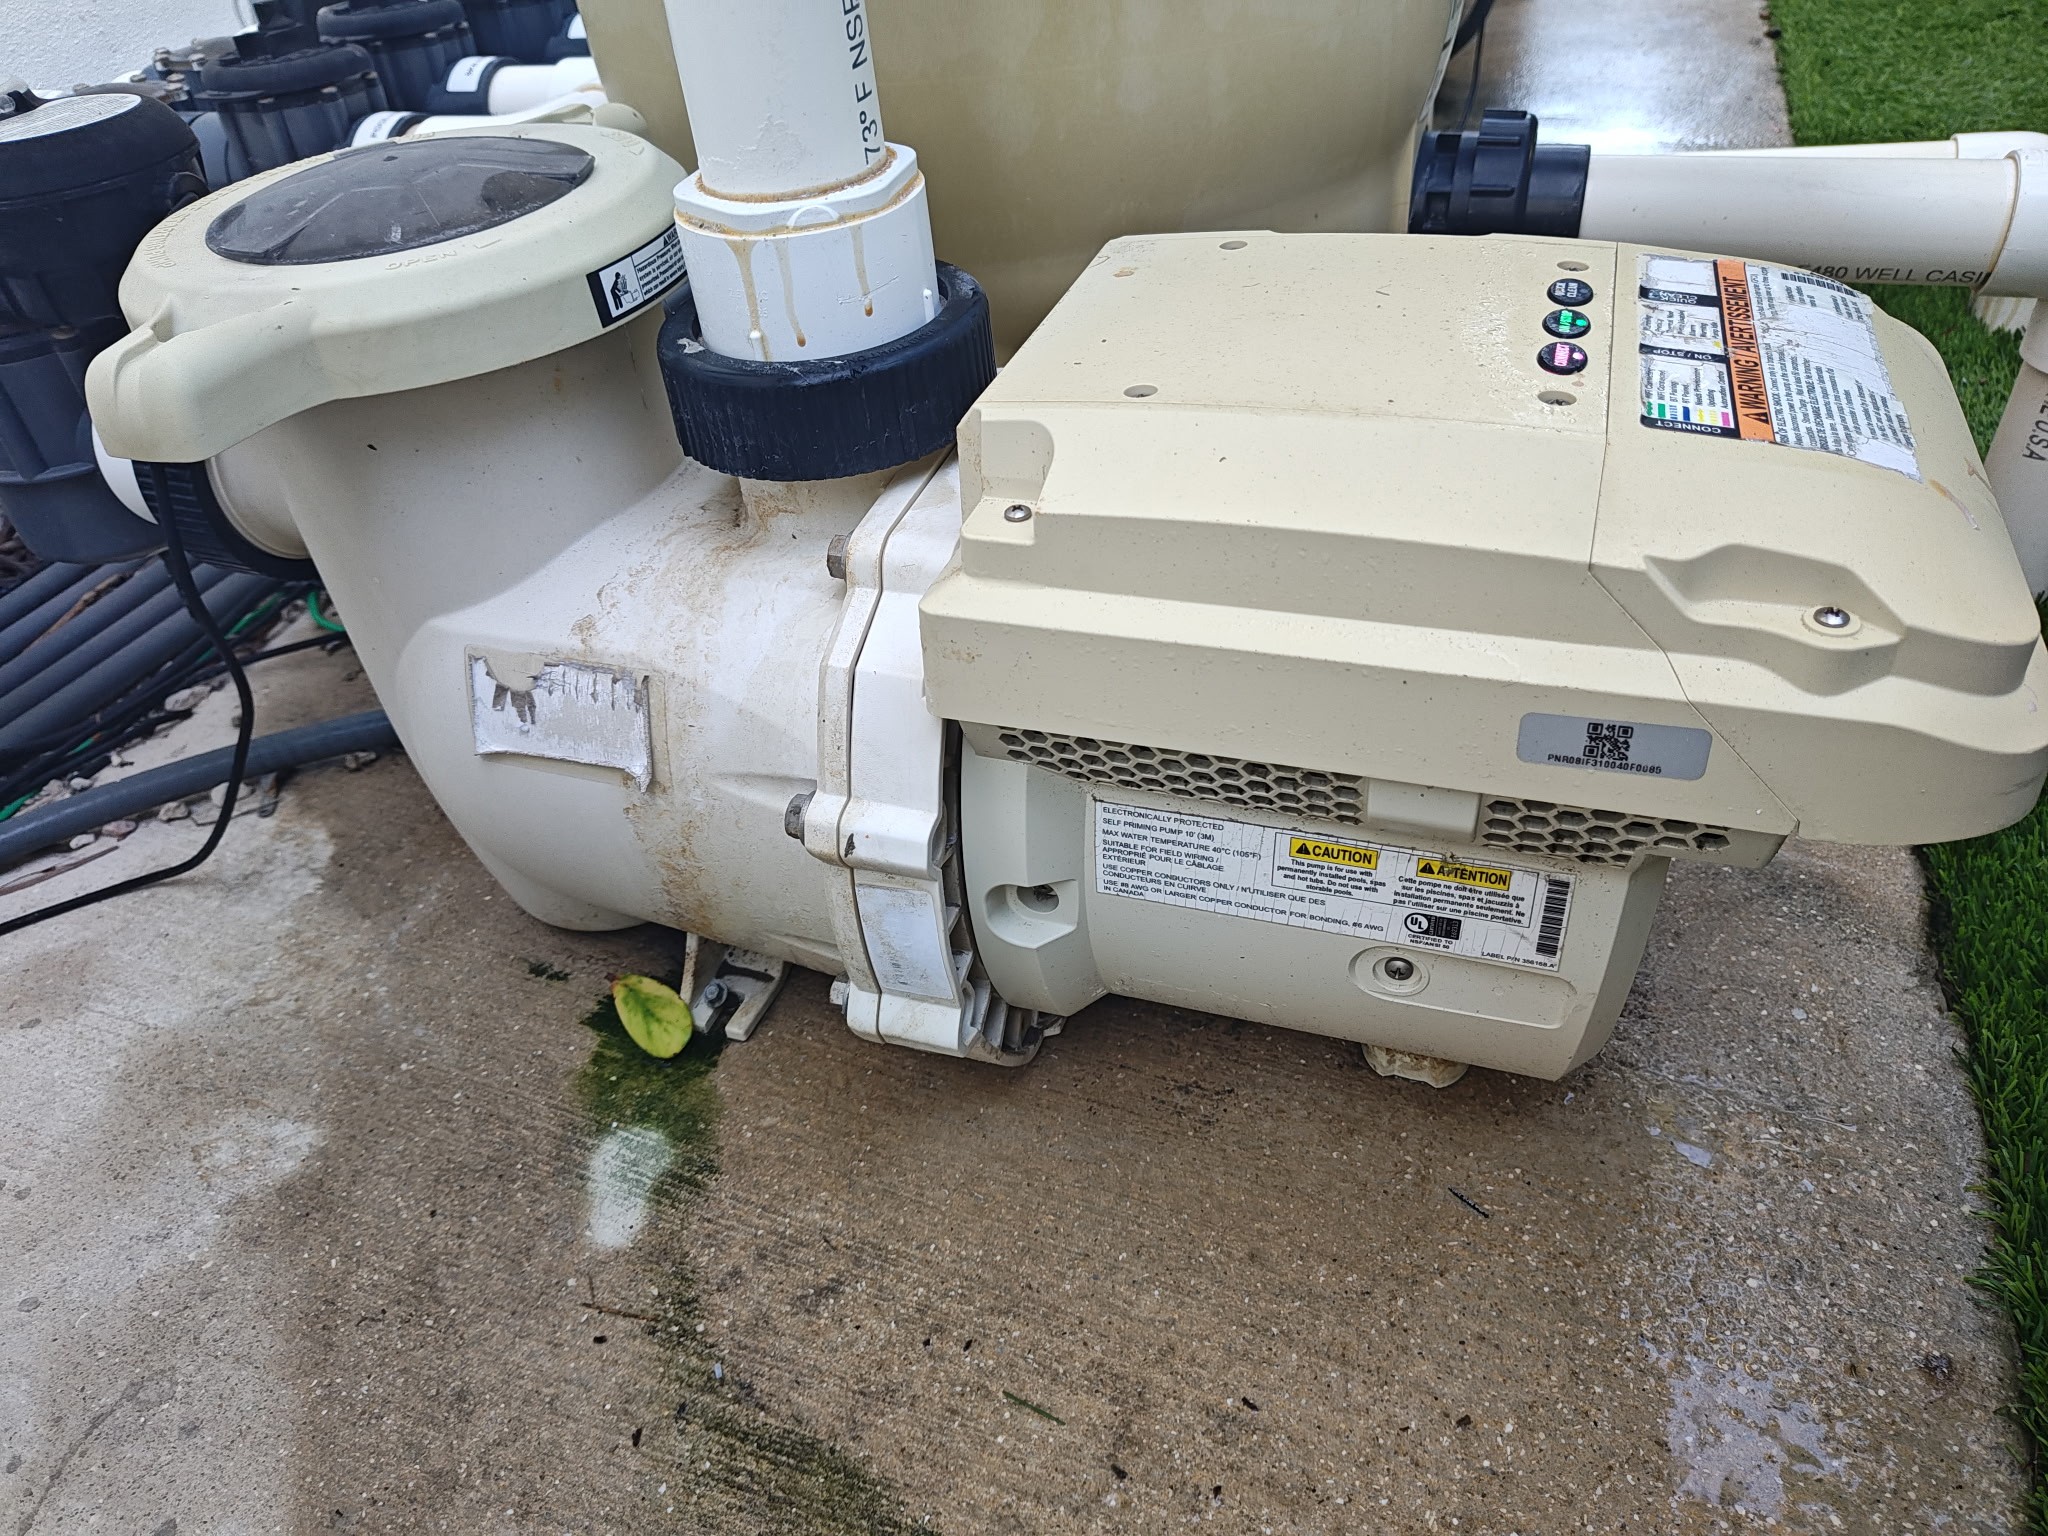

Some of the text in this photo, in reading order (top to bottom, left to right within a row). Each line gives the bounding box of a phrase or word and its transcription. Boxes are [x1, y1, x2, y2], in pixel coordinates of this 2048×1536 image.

[854, 81, 872, 103] F
[384, 248, 458, 271] OPEN
[1855, 267, 1918, 282] WELL
[1722, 276, 1756, 353] AVERTISSEMENT
[1734, 359, 1766, 411] WARNING
[1695, 393, 1703, 406] Needs
[1707, 389, 1716, 407] Updating
[1719, 385, 1728, 409] Automation
[1656, 420, 1721, 433] CONNECT
[1103, 807, 1224, 830] ELECTRONICALLY PROTECTED
[1102, 818, 1121, 826] SELF
[1124, 821, 1157, 832] PRIMING
[1160, 826, 1183, 836] PUMP
[1197, 832, 1214, 842] (3M)
[1102, 829, 1261, 861] MAX WATER TEMPERATURE 40°C (105°F)
[1103, 839, 1139, 850] SUITABLE
[1140, 845, 1157, 853] FOR
[1159, 848, 1182, 857] FIELD
[1185, 853, 1214, 863] WIRING
[1312, 845, 1372, 865] CAUTION
[1102, 847, 1146, 858] APPROPRIÉ
[1149, 854, 1172, 863] POUR
[1185, 859, 1224, 872] CÂBLAGE
[1102, 853, 1146, 866] EXTÉRIEUR
[1291, 859, 1305, 867] This
[1307, 862, 1325, 871] pump
[1103, 870, 1162, 885] CONDUCTEURS
[1277, 865, 1317, 877] permanently
[1319, 871, 1346, 881] installed
[1348, 876, 1368, 885] pools,
[1283, 872, 1296, 880] and
[1309, 877, 1325, 885] tubs.
[1364, 885, 1378, 893] with
[1113, 887, 1144, 897] CANADA
[1120, 866, 1152, 877] COPPER
[1154, 872, 1211, 887] CONDUCTORS
[1213, 882, 1234, 892] ONLY
[1241, 886, 1286, 899] N'UTILISER
[1288, 894, 1306, 903] QUE
[1308, 898, 1326, 906] DES
[1306, 884, 1353, 896] storable pools.
[1398, 876, 1417, 884] Cette
[1418, 880, 1442, 889] pompe
[1454, 885, 1467, 893] doit
[1484, 890, 1510, 899] utilisée
[1130, 884, 1149, 892] AWG
[1164, 889, 1197, 900] LARGER
[1198, 895, 1232, 906] COPPER
[1234, 902, 1287, 916] CONDUCTOR
[1290, 911, 1307, 919] FOR
[1364, 923, 1383, 932] AWG
[1394, 890, 1431, 901] installation
[1433, 896, 1474, 908] permanente
[1476, 905, 1513, 916] seulement.
[1426, 888, 1456, 899] piscines,
[1485, 897, 1514, 907] jacuzzis
[1407, 900, 1434, 910] l'utiliser
[1463, 910, 1488, 919] piscine
[1490, 914, 1524, 924] portative.
[1410, 916, 1424, 930] UL
[1408, 934, 1443, 943] CERTIFIED
[1410, 939, 1440, 948] NSF/ANSI
